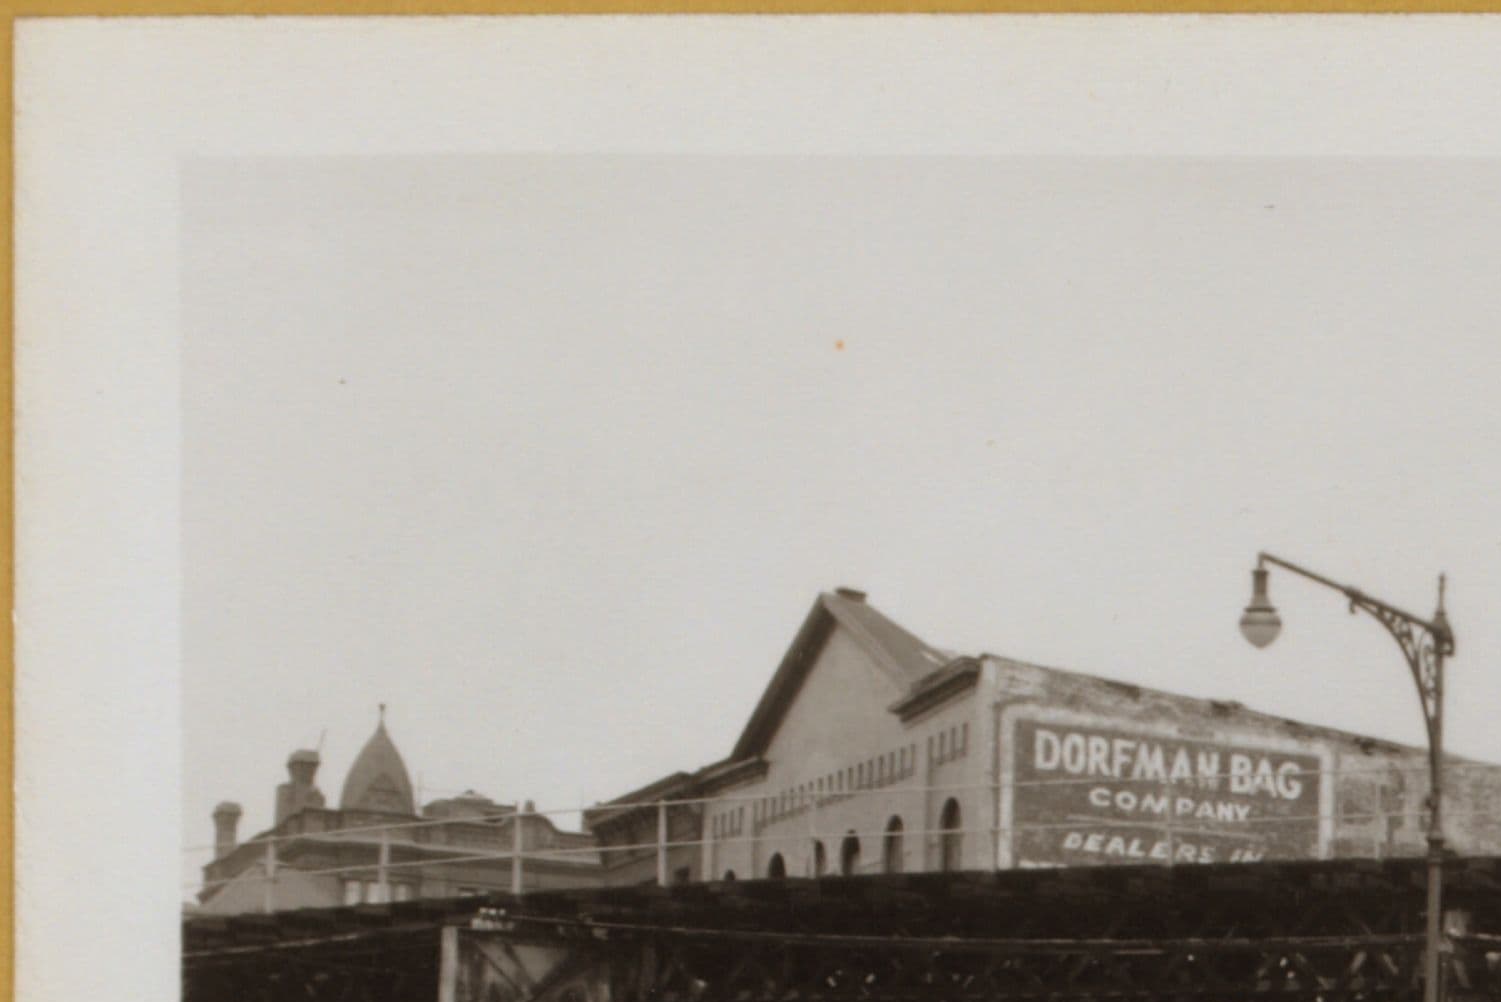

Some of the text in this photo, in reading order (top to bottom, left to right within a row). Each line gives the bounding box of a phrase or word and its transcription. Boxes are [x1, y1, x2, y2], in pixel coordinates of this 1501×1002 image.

[1034, 729, 1303, 800] DORFMAN BAG
[1089, 787, 1252, 822] COMPANY
[1062, 832, 1217, 864] DEALERS
